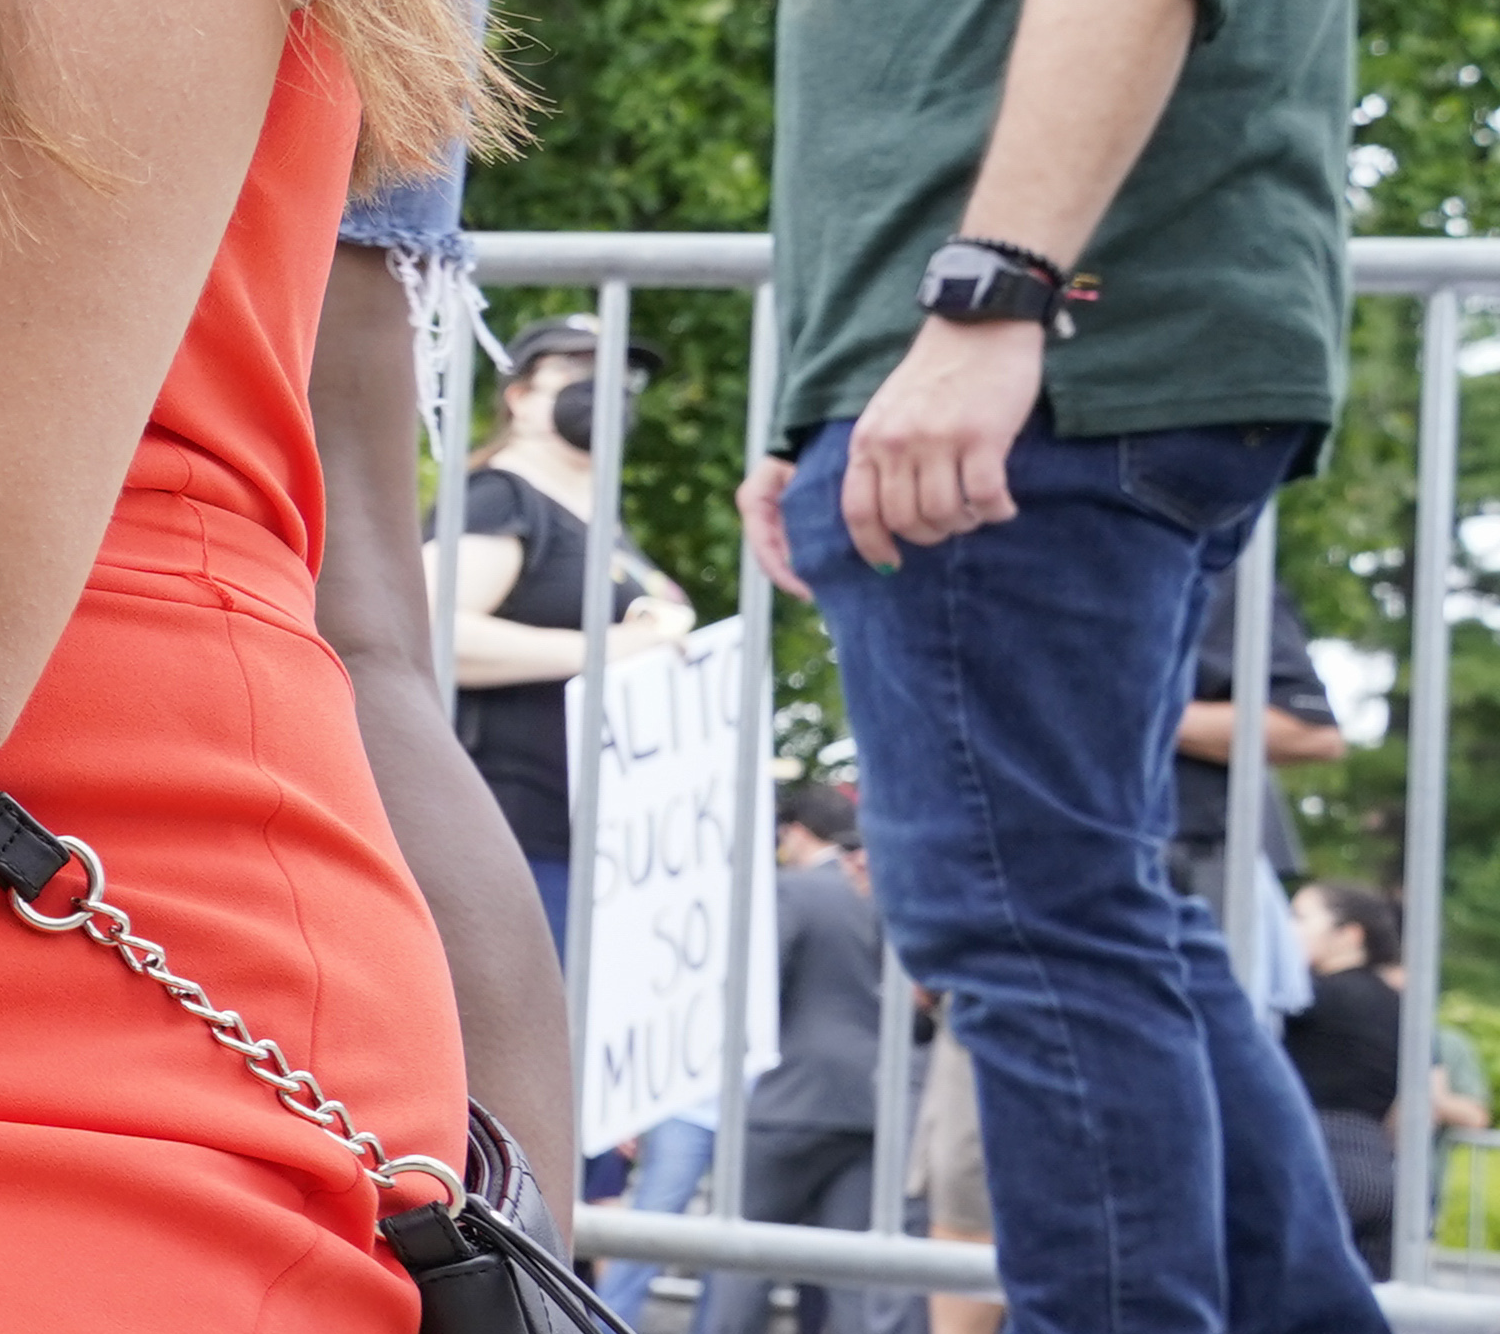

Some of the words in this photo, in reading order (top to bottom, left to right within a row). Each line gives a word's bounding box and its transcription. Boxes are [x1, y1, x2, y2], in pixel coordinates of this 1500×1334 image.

[595, 771, 732, 906] SUCK
[651, 899, 710, 1000] SO
[602, 995, 724, 1127] MUC
